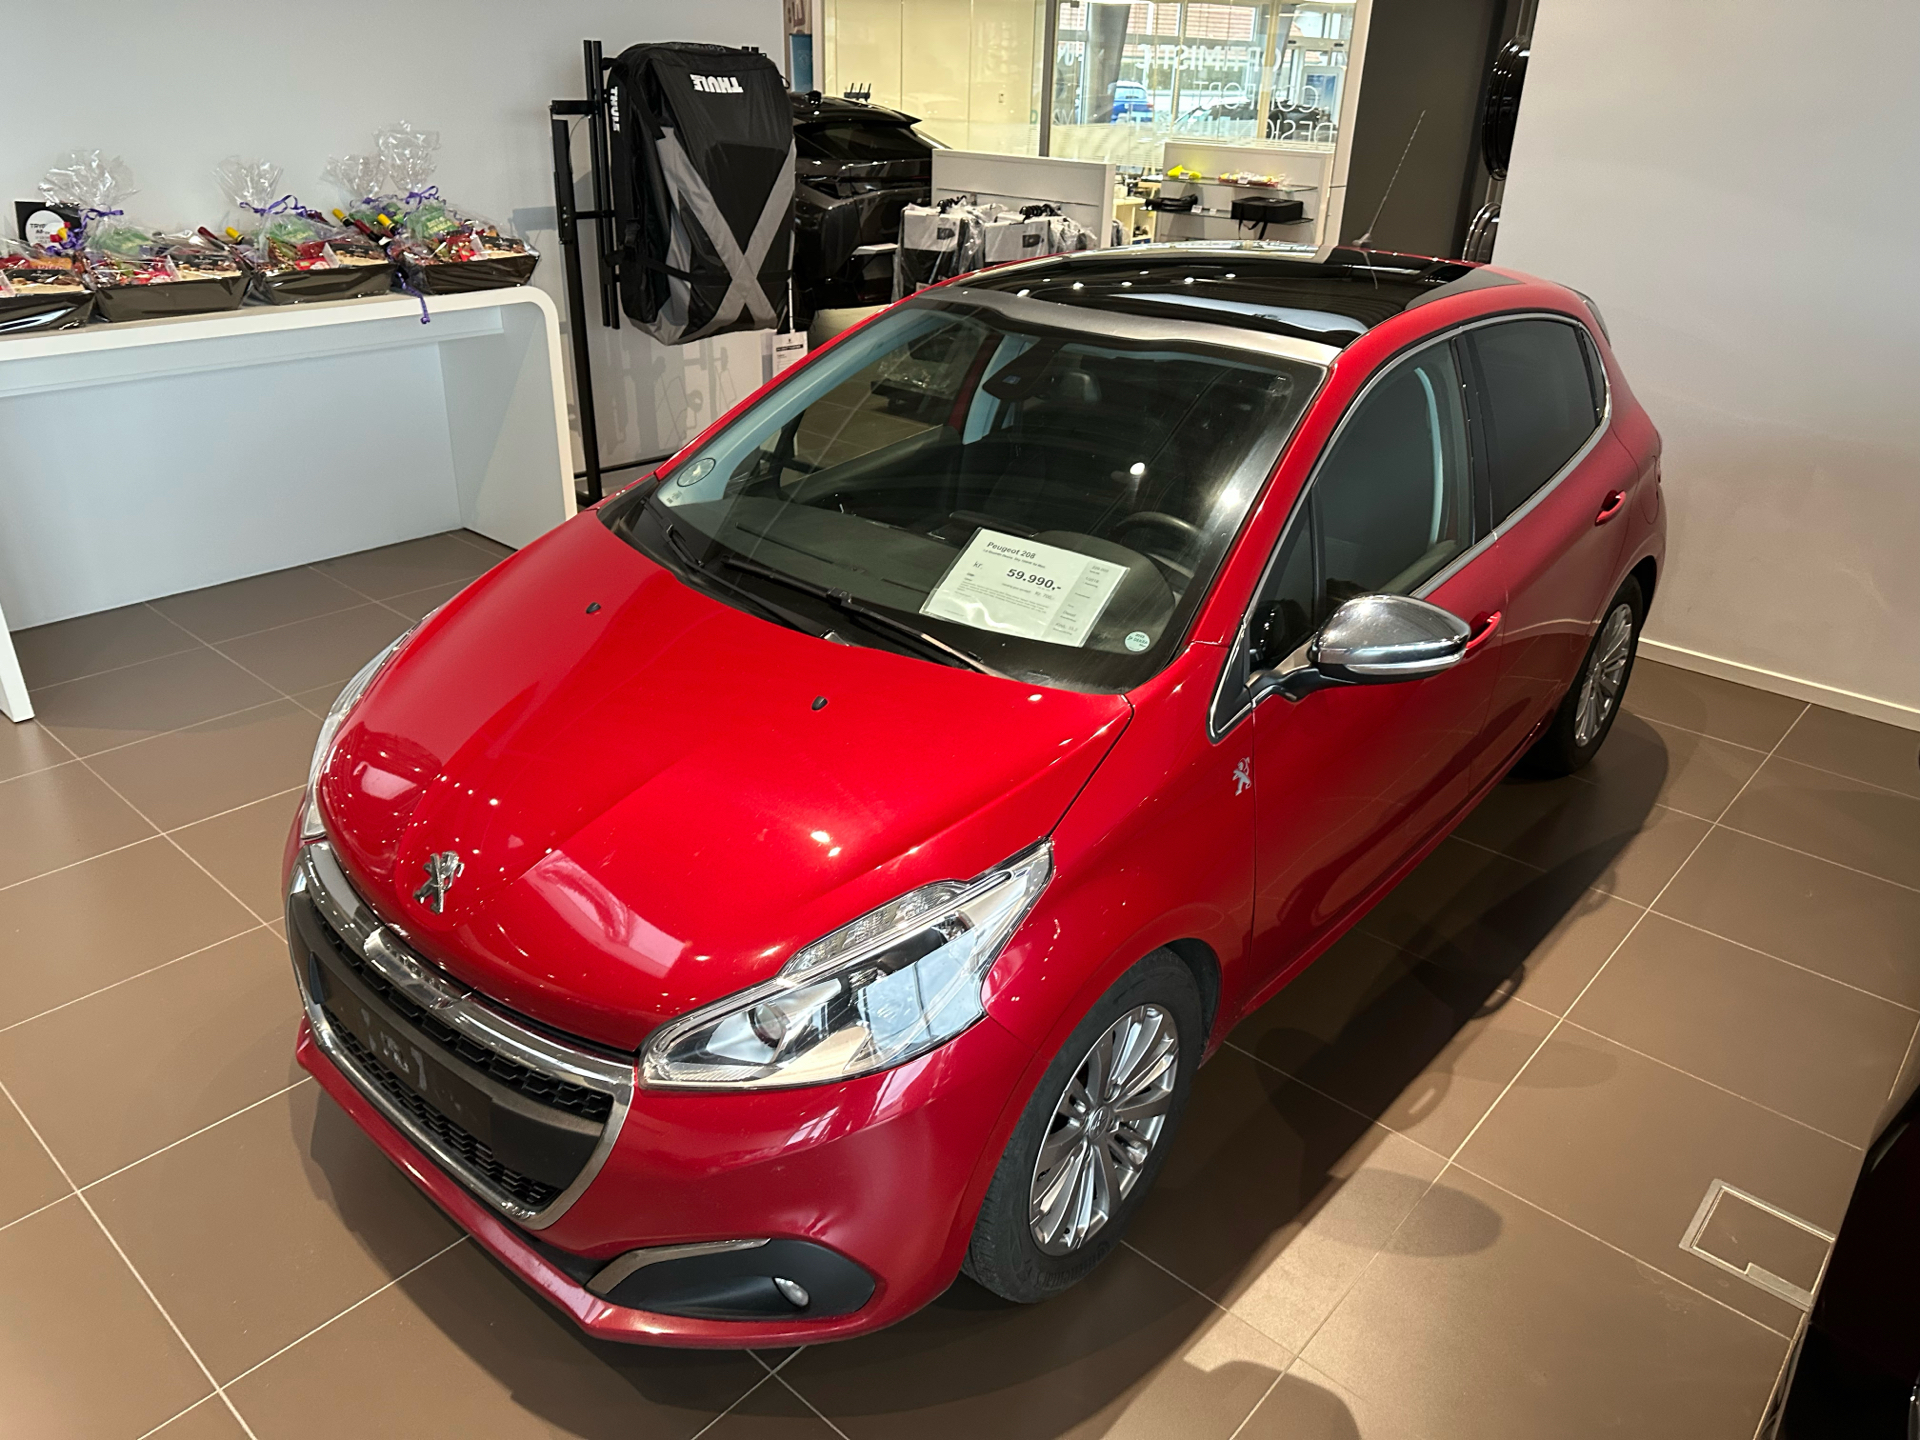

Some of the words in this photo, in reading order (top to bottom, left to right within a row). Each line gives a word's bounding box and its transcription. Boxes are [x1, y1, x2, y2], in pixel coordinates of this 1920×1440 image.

[689, 73, 744, 94] THULE
[610, 86, 621, 133] THULE
[987, 541, 1020, 555] Peugeot
[1020, 550, 1036, 559] 208
[1006, 568, 1062, 591] 59.990,-
